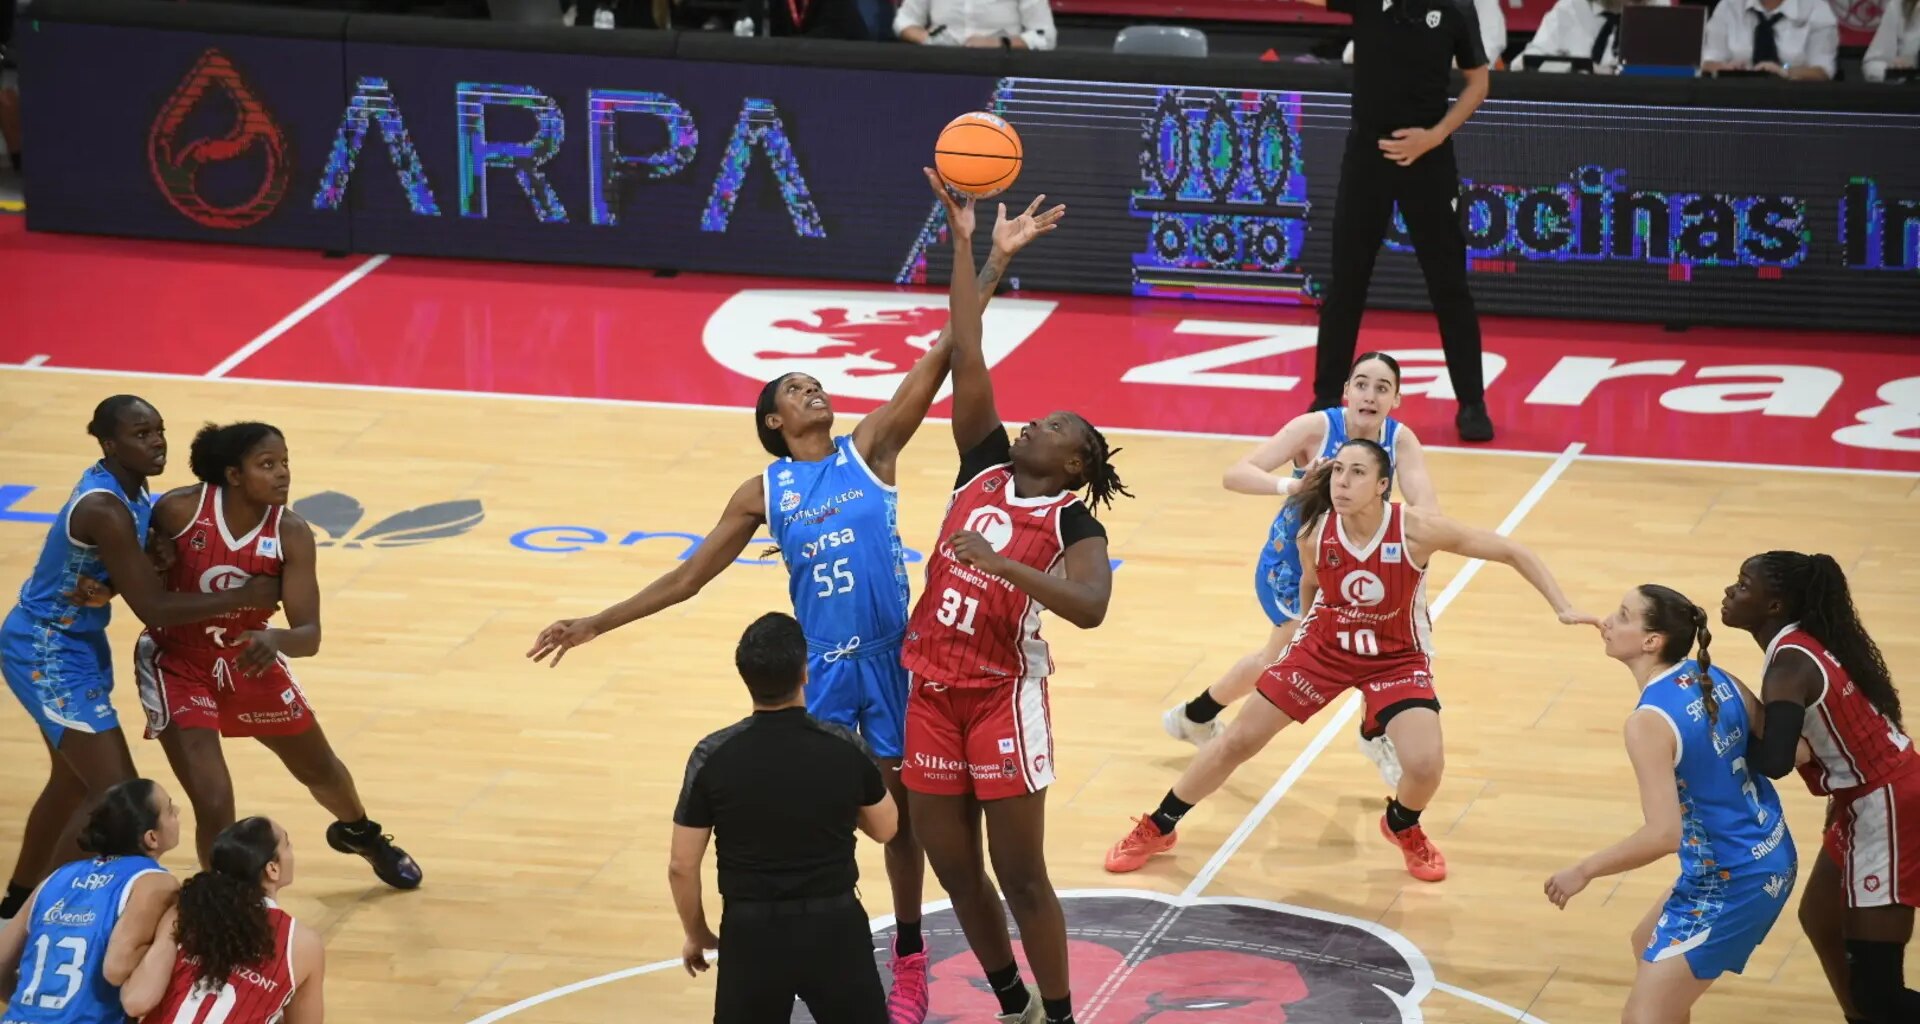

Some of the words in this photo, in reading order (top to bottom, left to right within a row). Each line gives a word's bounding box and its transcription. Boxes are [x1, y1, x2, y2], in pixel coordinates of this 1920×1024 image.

[1383, 166, 1804, 264] ocinas
[835, 488, 864, 504] LEÓN
[812, 557, 855, 598] 55
[949, 564, 989, 591] ZARAGOZA
[936, 587, 979, 636] 31
[1336, 628, 1380, 656] 10
[1287, 670, 1327, 706] Silken
[914, 751, 968, 771] Silken
[924, 771, 958, 781] HOTELES
[21, 934, 88, 1010] 13
